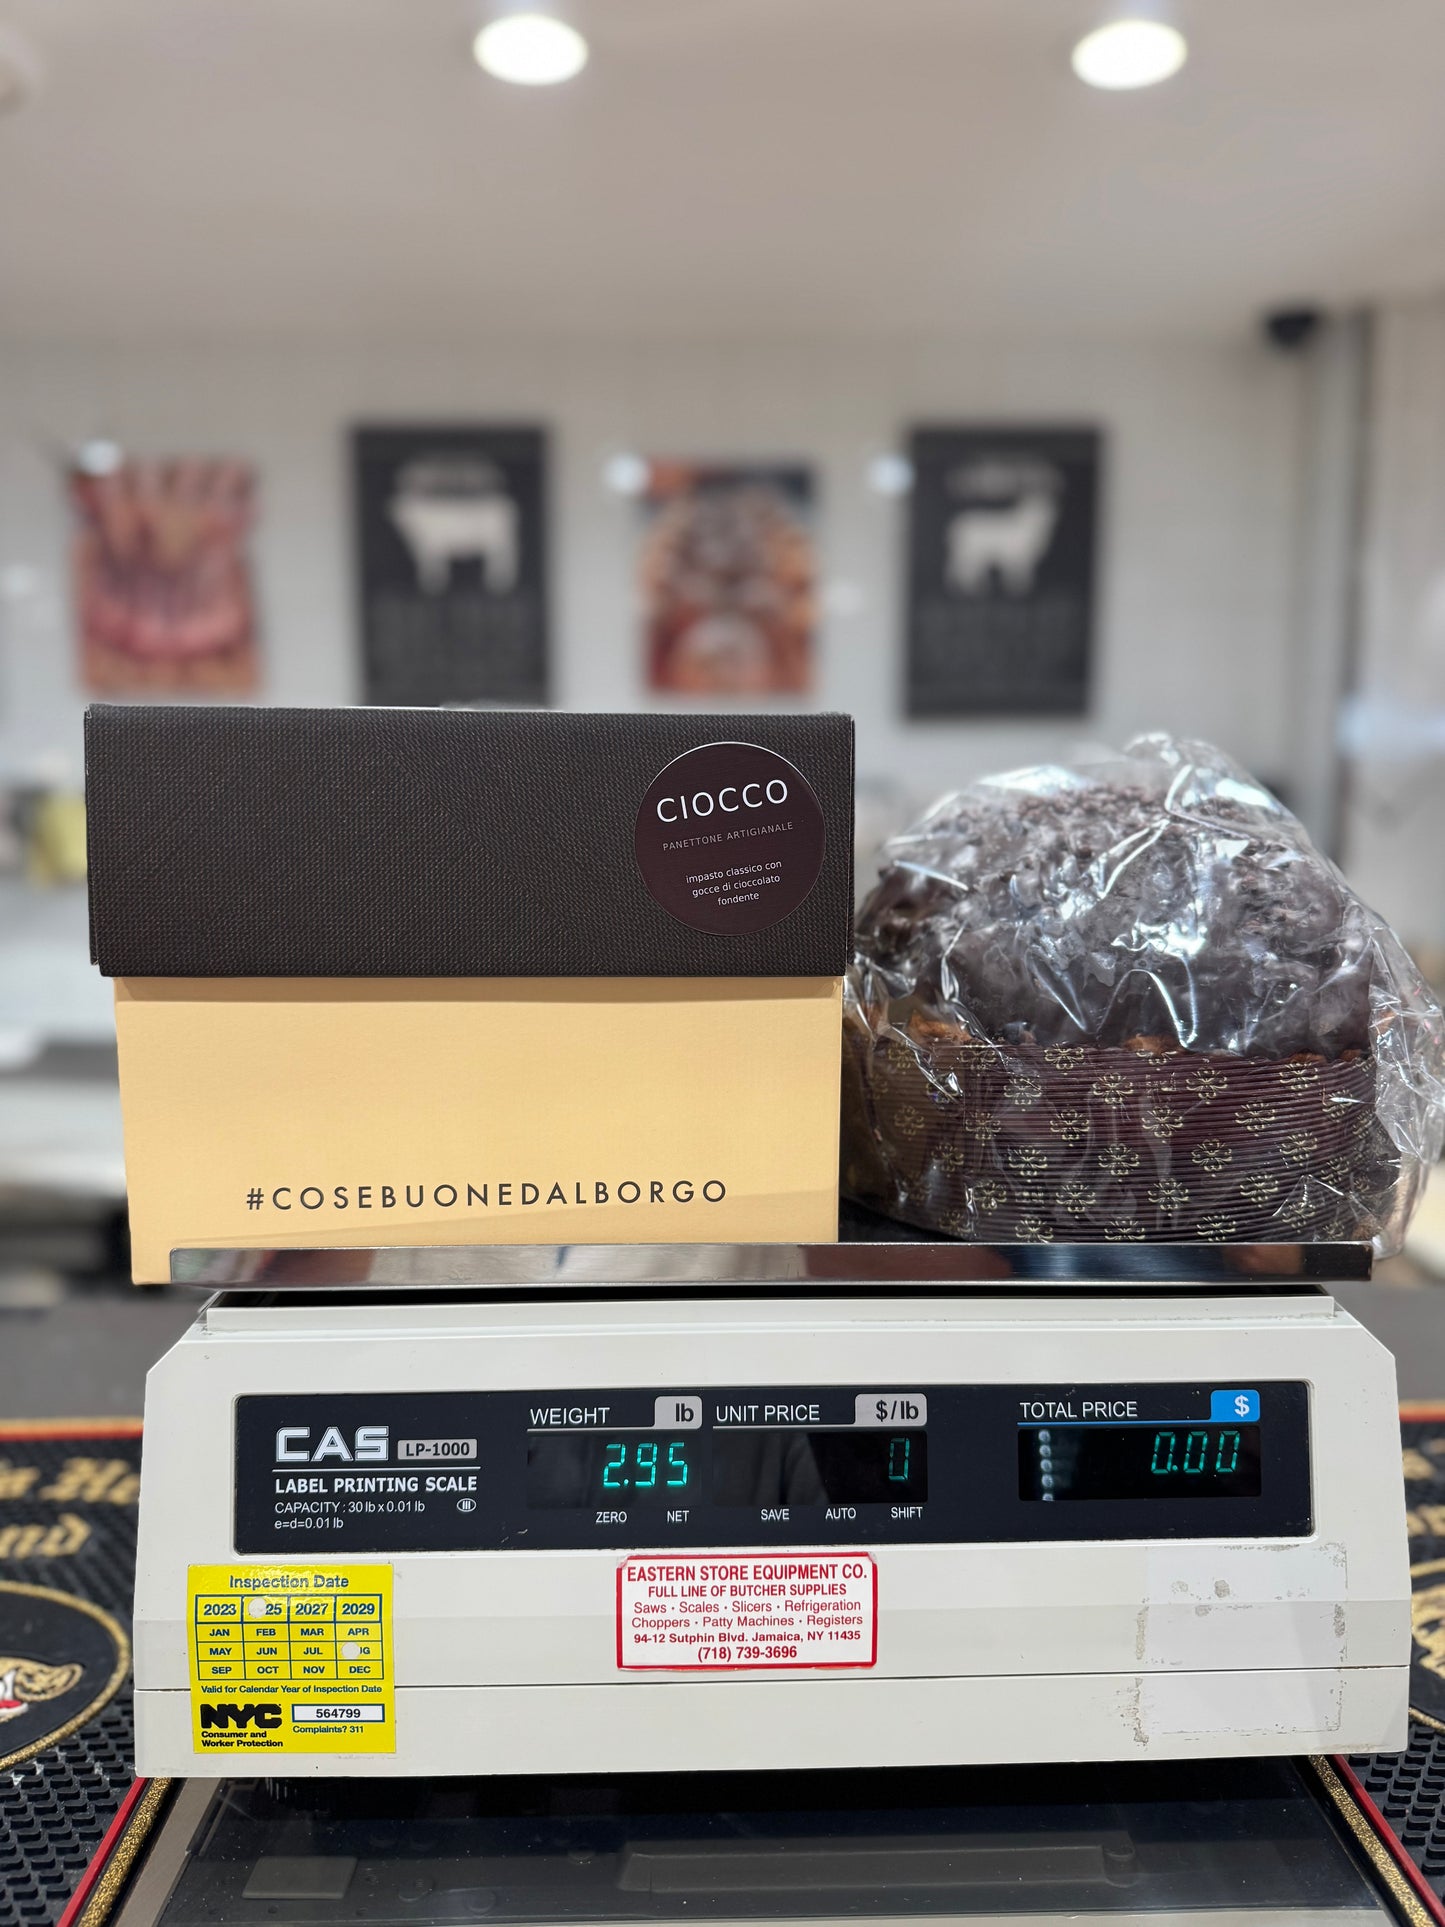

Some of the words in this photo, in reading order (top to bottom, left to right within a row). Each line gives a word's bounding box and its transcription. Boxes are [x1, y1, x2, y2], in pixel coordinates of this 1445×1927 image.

[656, 779, 788, 822] CIOCCO
[663, 834, 723, 851] PANETTONE
[727, 822, 793, 840] ARTIGIANALE
[686, 870, 724, 885] impasto
[726, 864, 763, 877] classico
[765, 860, 782, 870] con
[692, 886, 720, 898] gocce
[722, 880, 731, 891] di
[733, 875, 780, 890] cioccolato
[718, 892, 759, 906] fondente
[246, 1179, 726, 1211] #COSEBUONEDALBORGO
[675, 1403, 694, 1422] lb
[1020, 1402, 1077, 1418] TOTAL
[1083, 1401, 1137, 1417] PRICE
[1234, 1395, 1249, 1417] $
[530, 1407, 610, 1425] WEIGHT
[716, 1406, 759, 1422] UNIT
[764, 1405, 820, 1421] PRICE
[276, 1426, 389, 1462] CAS
[406, 1442, 470, 1456] LP-1000
[889, 1437, 910, 1481] 0
[1151, 1431, 1240, 1473] 0.00
[603, 1443, 688, 1487] 2.95
[275, 1478, 328, 1493] LABEL
[334, 1477, 418, 1492] PRINTING
[425, 1476, 477, 1491] SCALE
[275, 1502, 340, 1514] CAPACITY
[348, 1501, 363, 1512] 30
[365, 1501, 375, 1512] lb
[378, 1503, 384, 1512] x
[387, 1501, 412, 1512] 0.01
[414, 1500, 425, 1511] lb
[761, 1508, 789, 1520] SAVE
[825, 1507, 856, 1519] AUTO
[891, 1506, 922, 1519] SHIFT
[275, 1518, 330, 1529] e=d=0.01
[333, 1517, 343, 1528] lb
[596, 1511, 627, 1524] ZERO
[667, 1510, 689, 1523] NET
[627, 1566, 695, 1581] EASTERN
[700, 1565, 748, 1580] STORE
[753, 1564, 838, 1580] EQUIPMENT
[842, 1563, 867, 1578] CO.
[230, 1575, 309, 1589] Inspection
[314, 1575, 349, 1588] Date
[648, 1586, 677, 1597] FULL
[681, 1586, 708, 1597] LINE
[711, 1585, 727, 1596] OF
[730, 1585, 786, 1596] BUTCHER
[789, 1584, 847, 1595] SUPPLIES
[204, 1604, 236, 1615] 2023
[295, 1604, 328, 1615] 2027
[342, 1604, 375, 1615] 2029
[634, 1602, 667, 1613] Saws
[679, 1601, 719, 1613] Scales
[732, 1601, 772, 1612] Slicers
[785, 1600, 861, 1614] Refrigeration
[632, 1617, 690, 1630] Choppers
[703, 1617, 734, 1629] Patty
[737, 1616, 794, 1626] Machines
[807, 1615, 862, 1627] Registers
[209, 1629, 230, 1637] JAN
[347, 1628, 369, 1636] APR
[634, 1634, 665, 1643] 94-12
[669, 1633, 714, 1645] Sutphin
[719, 1632, 748, 1642] Blvd.
[752, 1632, 803, 1643] Jamaica,
[807, 1631, 824, 1640] NY
[828, 1630, 861, 1640] 11435
[304, 1647, 323, 1655] JUL
[698, 1646, 731, 1662] (718)
[736, 1646, 797, 1659] 739-3696
[303, 1666, 325, 1674] NOV
[314, 1685, 359, 1694] Inspection
[200, 1703, 282, 1729] NYC
[316, 1709, 360, 1718] 564799
[293, 1726, 347, 1734] Complaints?
